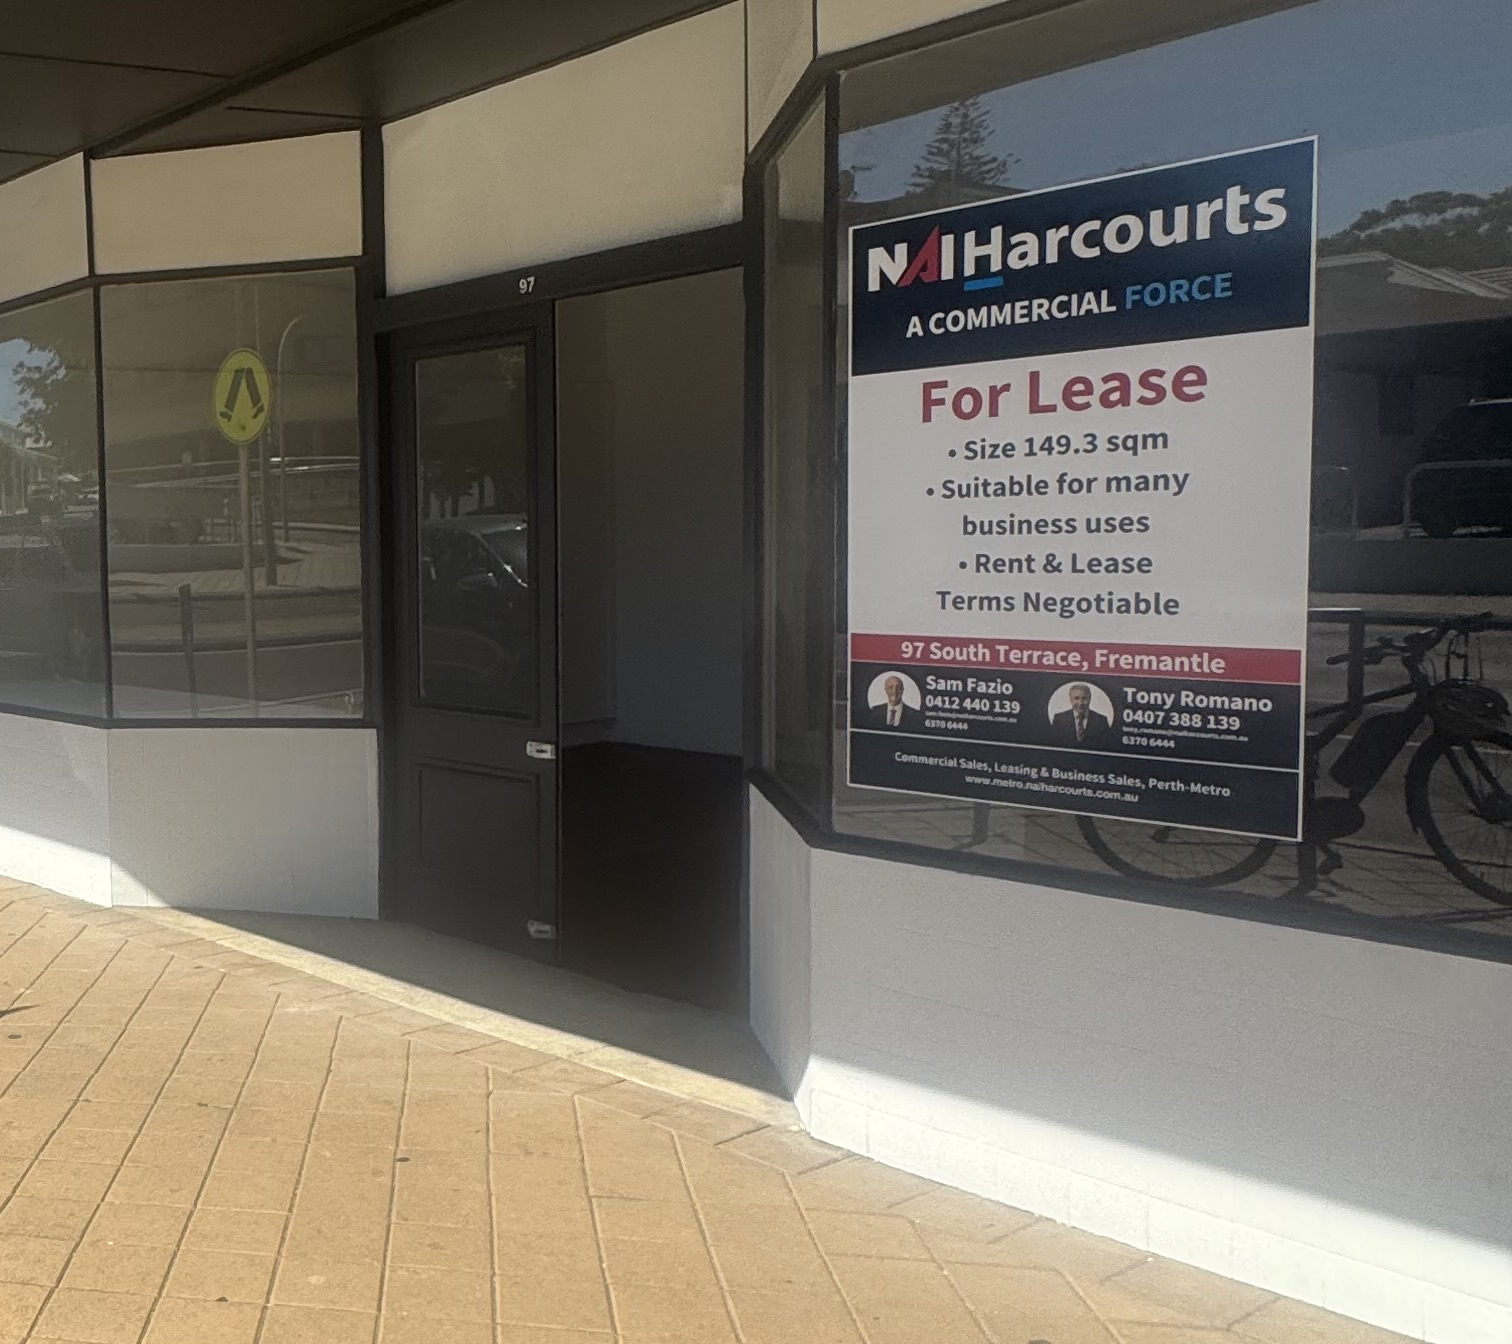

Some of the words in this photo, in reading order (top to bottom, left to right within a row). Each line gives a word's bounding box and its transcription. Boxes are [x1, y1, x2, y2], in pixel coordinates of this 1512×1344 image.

[868, 224, 954, 292] NAI
[963, 185, 1287, 278] Harcourts
[519, 276, 535, 294] 97
[906, 316, 923, 338] A
[929, 290, 1116, 335] COMMERCIAL
[1125, 272, 1233, 310] FORCE
[922, 380, 1011, 423] For
[1028, 365, 1208, 414] Lease
[964, 438, 1016, 460] Size
[1024, 433, 1098, 457] 149.3
[1106, 432, 1169, 456] sqm
[941, 474, 1049, 499] Suitable
[1056, 472, 1098, 494] for
[1106, 472, 1190, 496] many
[962, 514, 1077, 536] business
[1085, 515, 1150, 533] uses
[975, 553, 1036, 573] Rent
[1042, 553, 1063, 574] &
[1071, 553, 1153, 574] Lease
[936, 590, 1015, 611] Terms
[1024, 591, 1180, 619] Negotiable
[901, 642, 924, 658] 97
[929, 642, 989, 662] South
[996, 645, 1088, 671] Terrace,
[1095, 649, 1225, 674] Fremantle
[926, 675, 962, 692] Sam
[967, 678, 1013, 695] Fazio
[925, 695, 959, 710] 0412
[962, 698, 989, 711] 440
[994, 700, 1020, 714] 139
[1123, 687, 1175, 709] Tony
[1181, 691, 1273, 712] Romano
[1123, 709, 1165, 724] 0407
[1169, 713, 1202, 727] 388
[1207, 716, 1240, 731] 139
[1122, 736, 1147, 746] 6370
[1150, 738, 1175, 748] 6444
[894, 752, 957, 768] Commercial
[959, 758, 992, 773] Sales,
[994, 762, 1038, 778] Leasing
[1041, 767, 1049, 777] &
[1052, 767, 1105, 784] Business
[1108, 773, 1145, 789] Sales,
[1149, 778, 1230, 797] Perth-Metro
